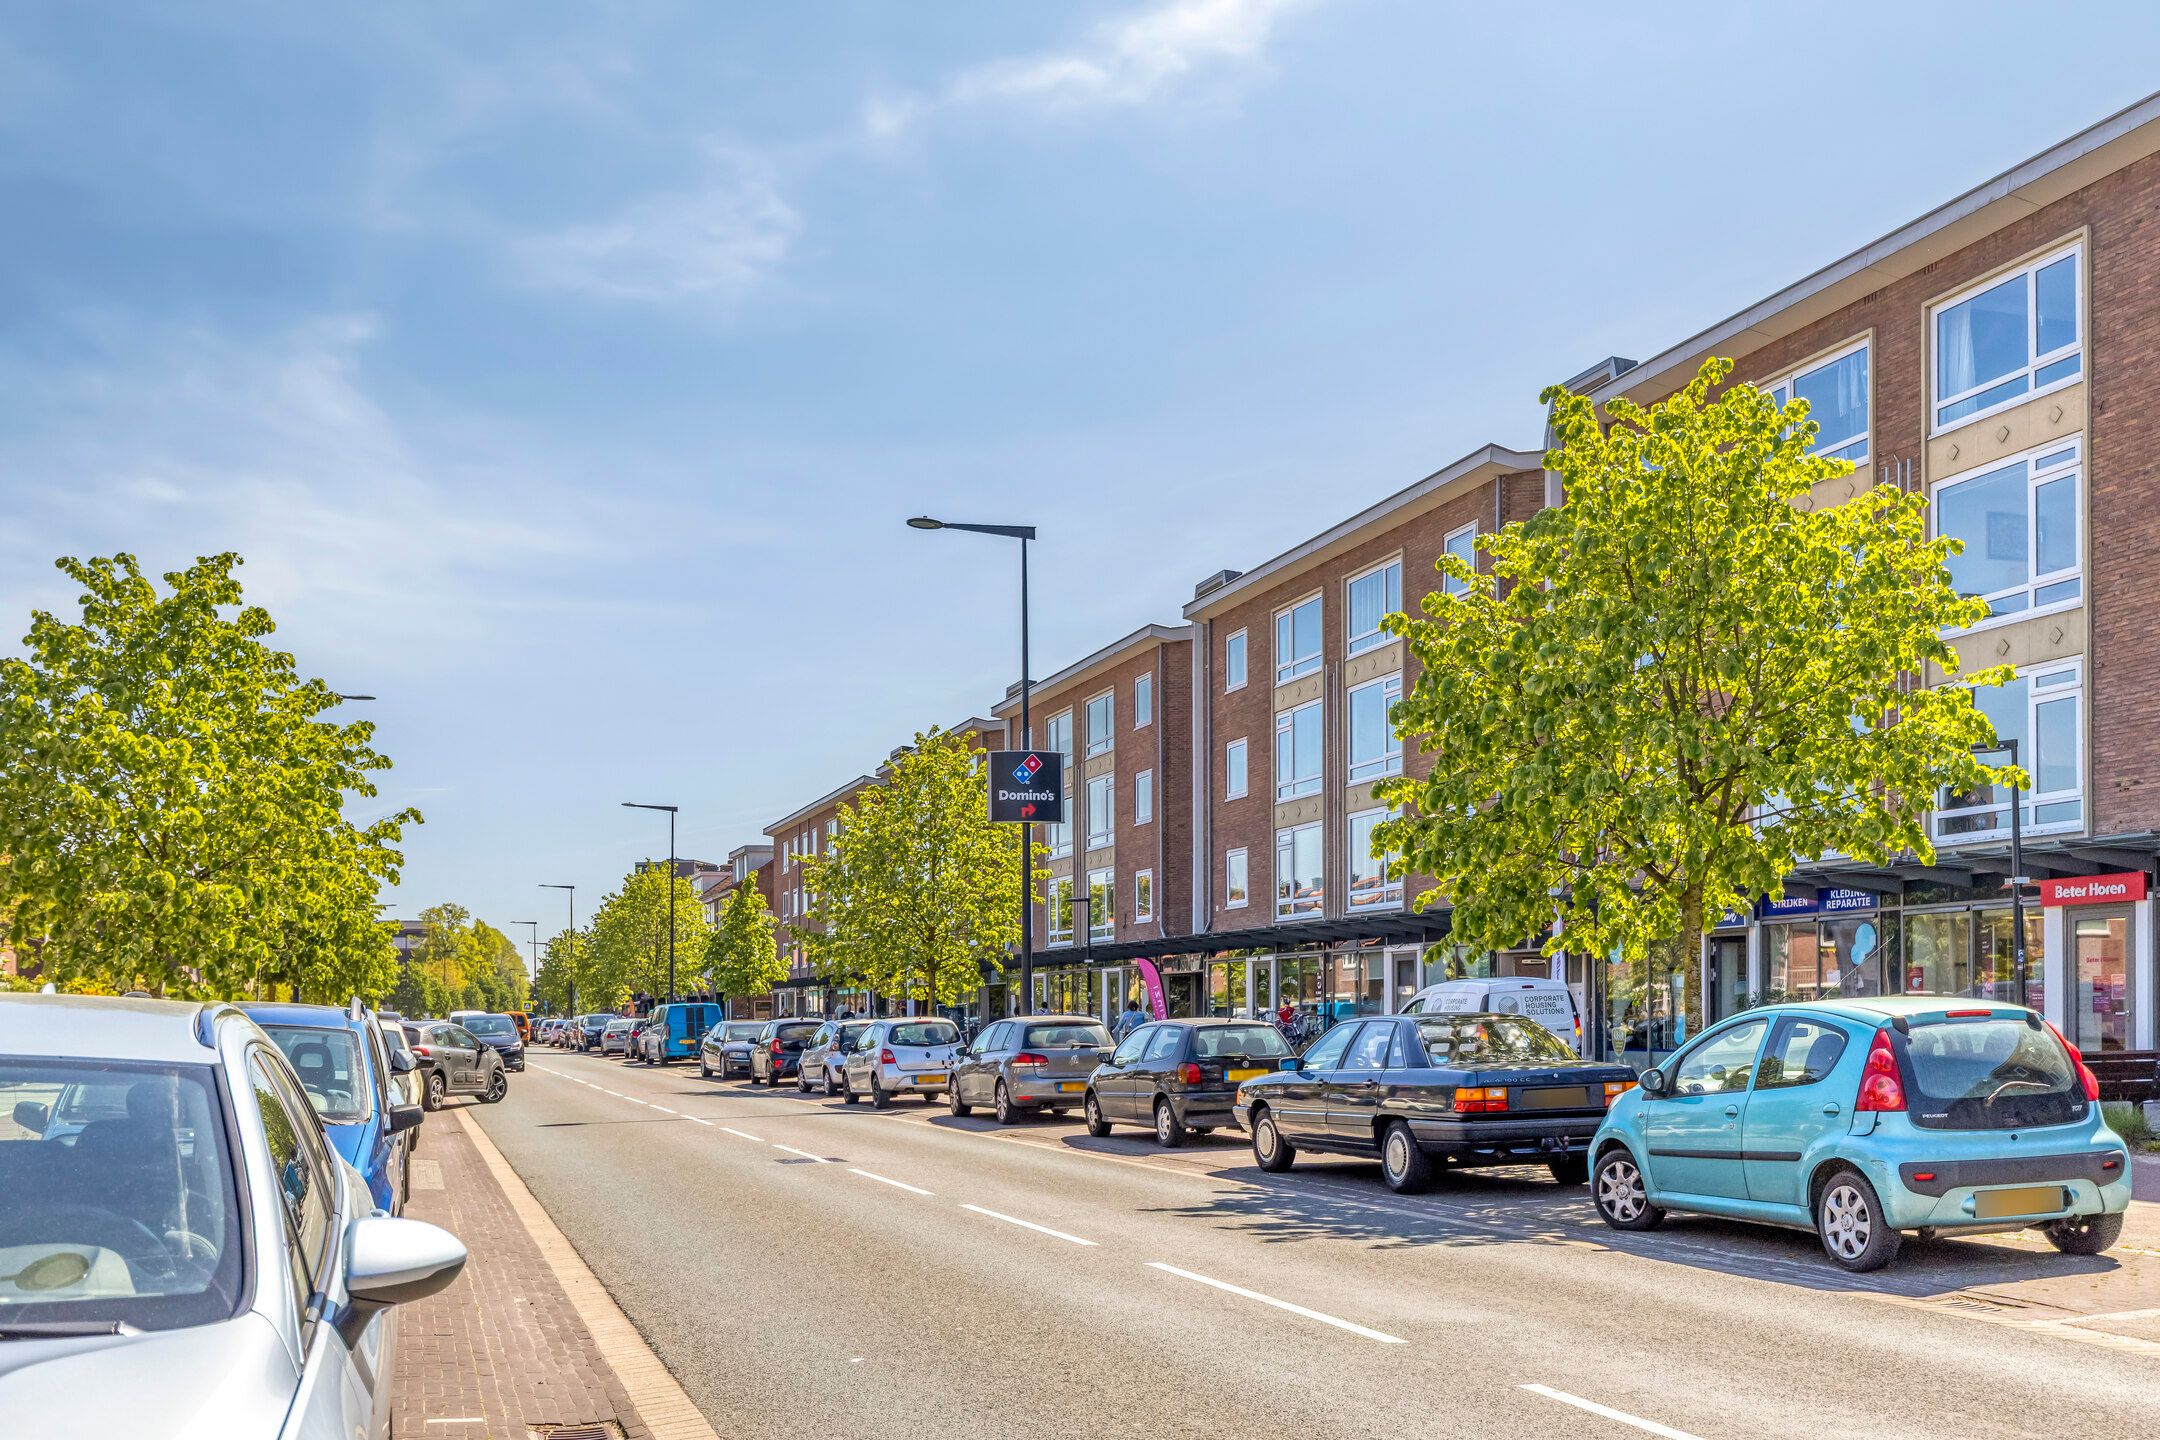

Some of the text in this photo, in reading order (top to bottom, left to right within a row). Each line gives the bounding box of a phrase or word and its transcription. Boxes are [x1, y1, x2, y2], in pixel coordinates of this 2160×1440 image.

[998, 789, 1055, 801] Domino's
[2054, 882, 2127, 899] Beter Horen
[1826, 897, 1871, 909] REPARATIE
[1524, 995, 1565, 1003] CORPORATE
[1526, 1008, 1565, 1016] SOLUTIONS
[2071, 1104, 2083, 1112] 107
